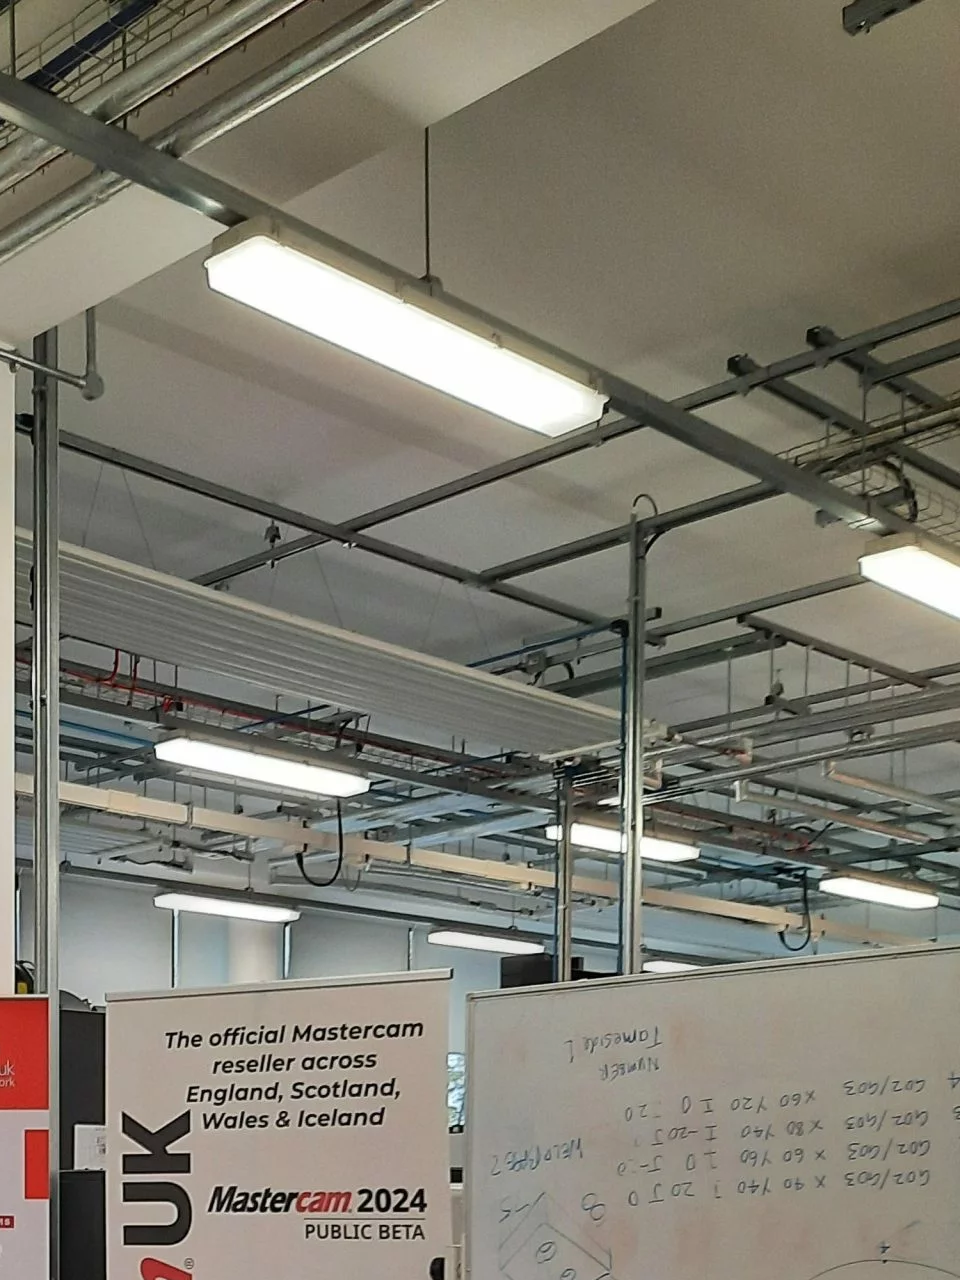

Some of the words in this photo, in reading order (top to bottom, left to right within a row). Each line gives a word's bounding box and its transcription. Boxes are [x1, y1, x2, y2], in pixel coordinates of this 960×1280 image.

[165, 1031, 203, 1050] The
[209, 1025, 286, 1047] official
[292, 1021, 425, 1044] Mastercam
[212, 1053, 296, 1075] reseller
[301, 1051, 378, 1072] across
[186, 1082, 284, 1107] England,
[290, 1077, 402, 1101] Scotland,
[202, 1110, 269, 1131] Wales
[275, 1111, 291, 1129] &
[297, 1107, 386, 1128] Iceland
[122, 1109, 193, 1246] UK
[207, 1186, 352, 1214] Mastercam
[357, 1189, 428, 1213] 2024
[304, 1224, 371, 1241] PUBLIC
[378, 1223, 426, 1240] BETA
